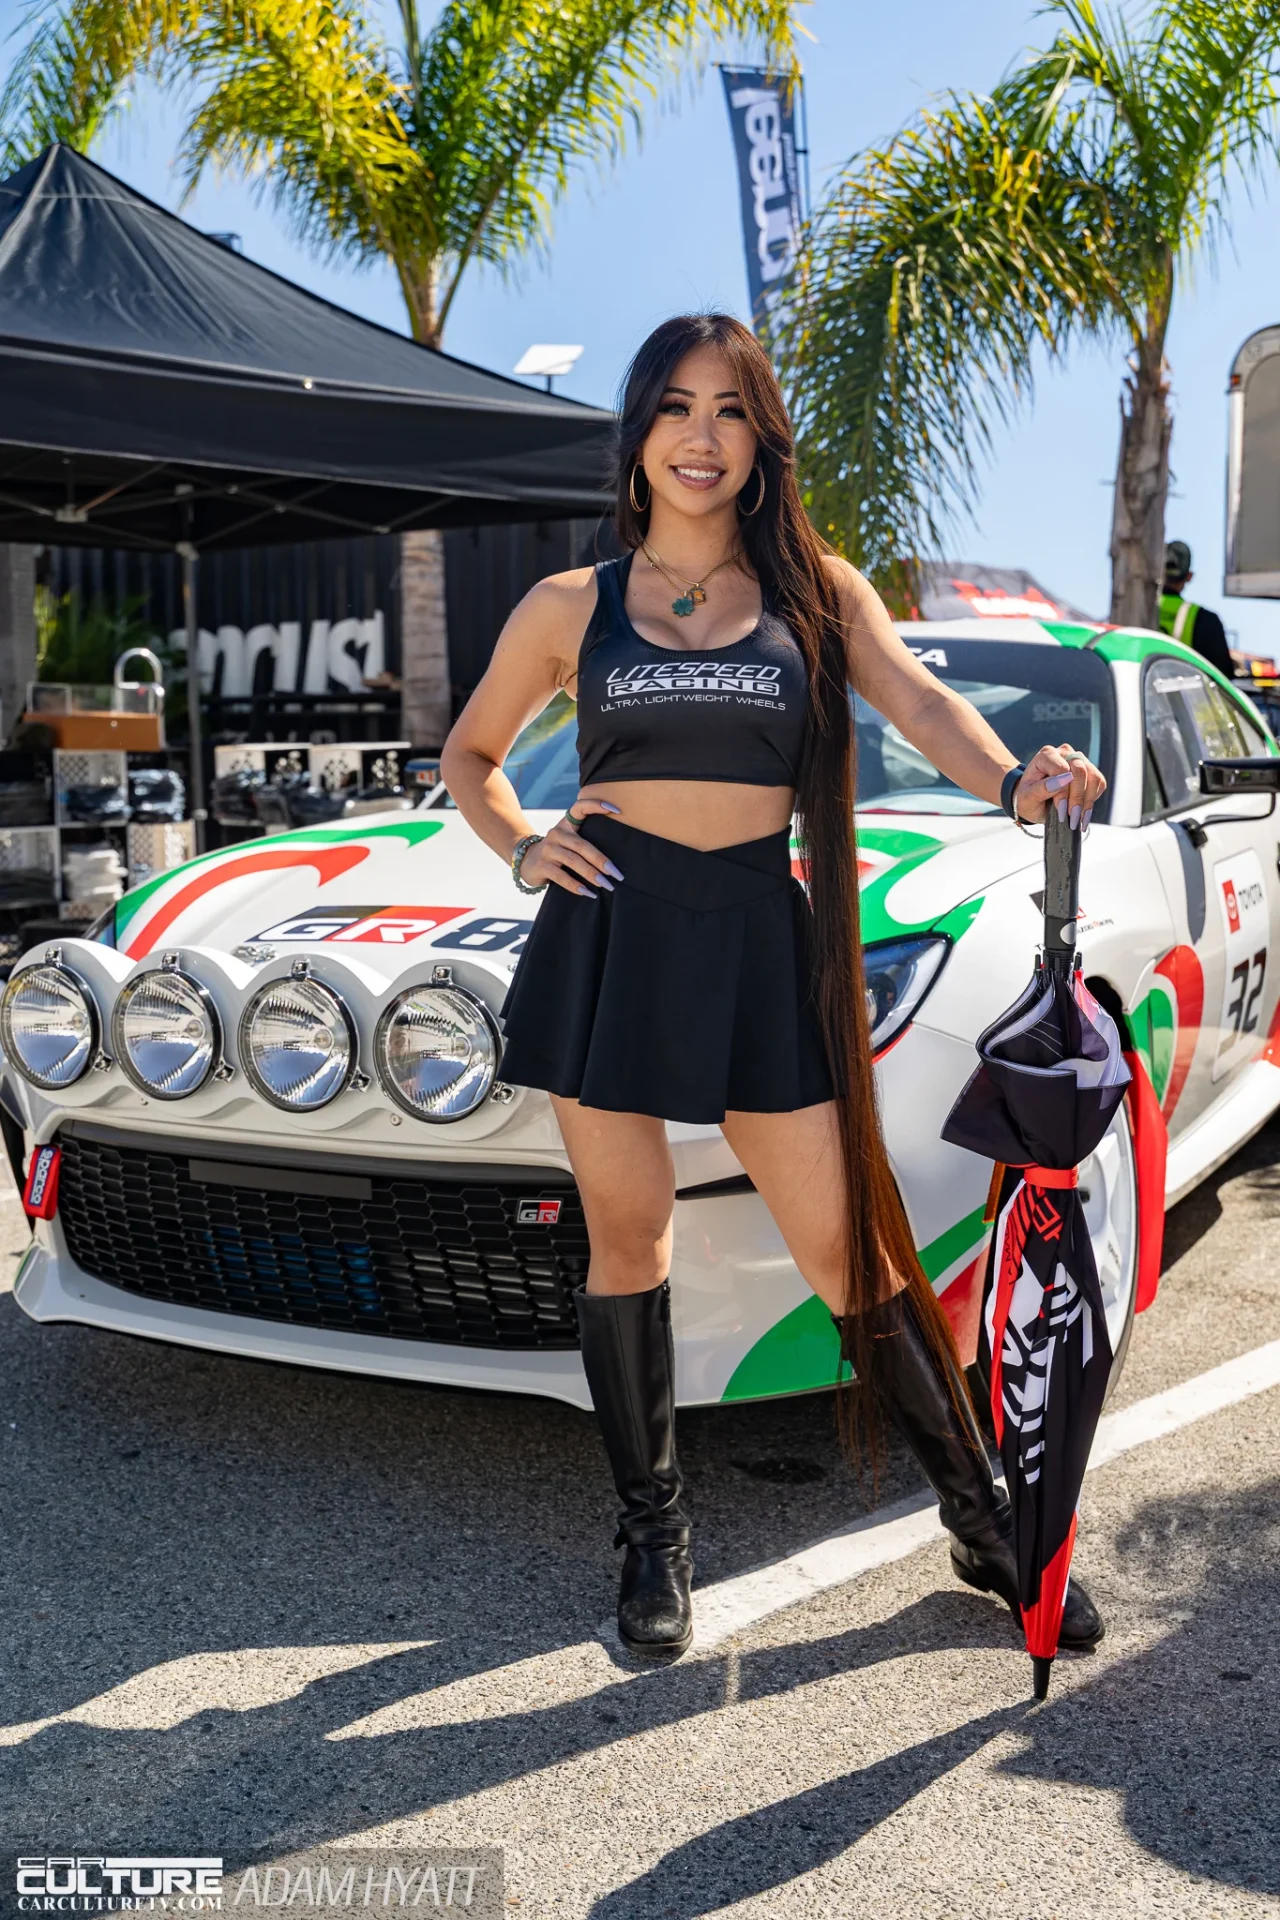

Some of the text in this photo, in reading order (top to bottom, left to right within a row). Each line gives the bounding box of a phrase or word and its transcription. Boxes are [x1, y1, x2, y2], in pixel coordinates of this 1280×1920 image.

[606, 662, 782, 684] LITESPEED
[608, 678, 780, 697] RACING
[600, 698, 641, 712] ULTRA
[735, 696, 786, 711] WHEELS
[257, 916, 438, 943] GR
[1217, 946, 1268, 1058] 32
[29, 1148, 54, 1205] sparco
